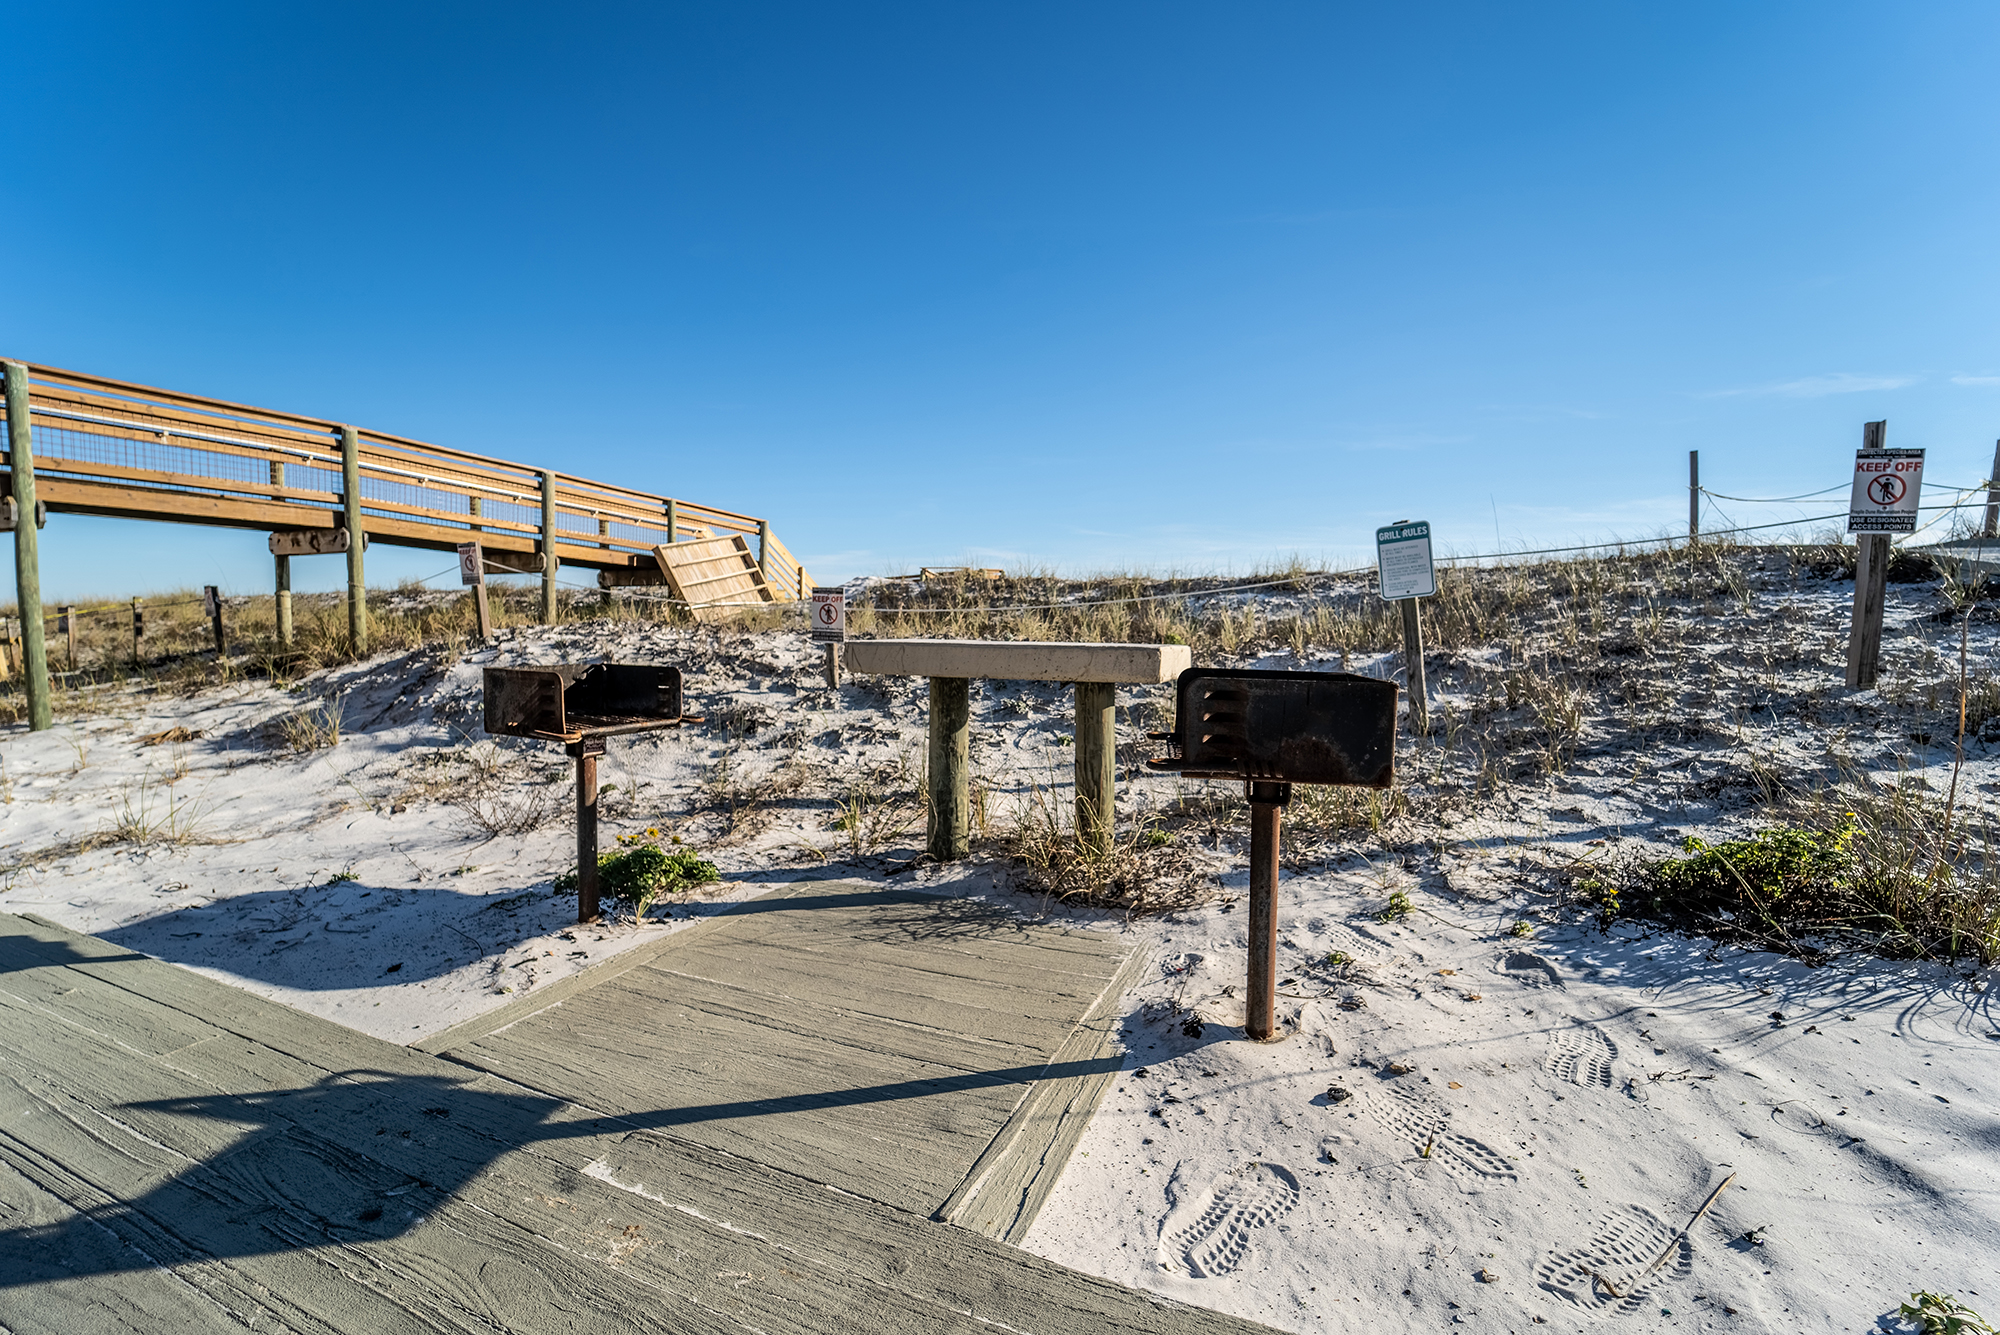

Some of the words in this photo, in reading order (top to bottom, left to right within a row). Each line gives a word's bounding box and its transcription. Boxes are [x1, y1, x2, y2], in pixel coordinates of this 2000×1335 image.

[1856, 462, 1891, 472] KEEP
[1895, 462, 1922, 472] OFF
[1379, 530, 1401, 541] GRILL
[1402, 526, 1427, 537] RULES
